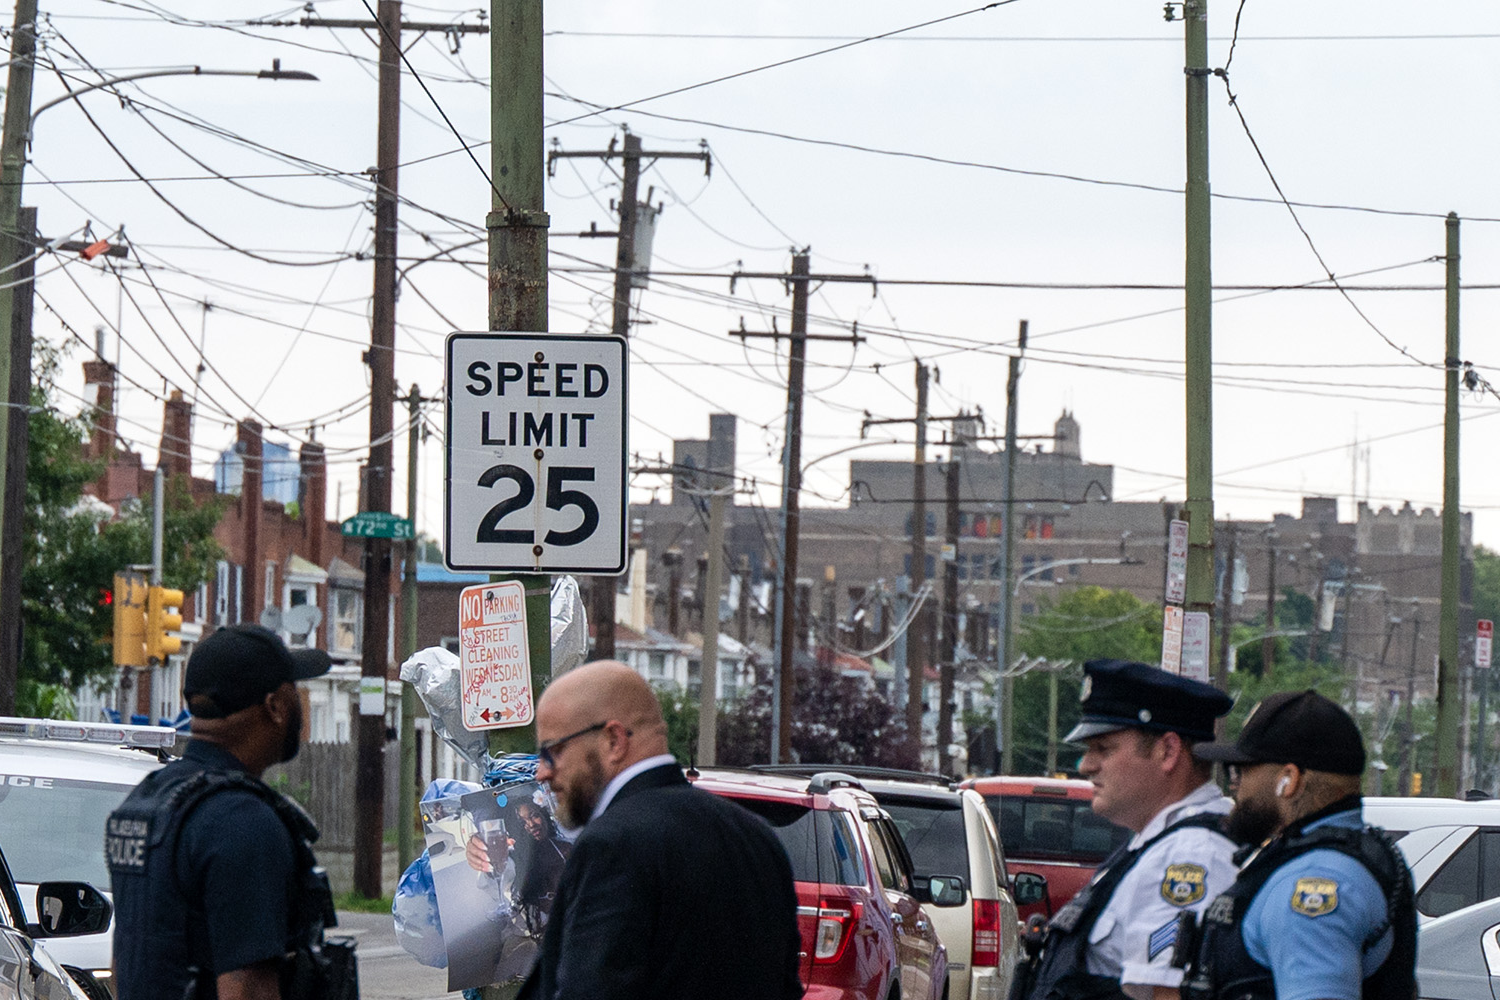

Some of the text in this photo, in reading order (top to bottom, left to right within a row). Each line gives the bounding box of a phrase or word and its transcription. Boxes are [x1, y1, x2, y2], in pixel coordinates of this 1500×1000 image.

[465, 360, 609, 398] SPEED
[481, 411, 595, 448] LIMIT
[476, 463, 600, 547] 25
[463, 594, 481, 622] NO
[484, 594, 520, 615] PARKING
[474, 627, 510, 645] STREET
[468, 644, 520, 664] CLEANING
[465, 662, 524, 686] WEDNESDAY
